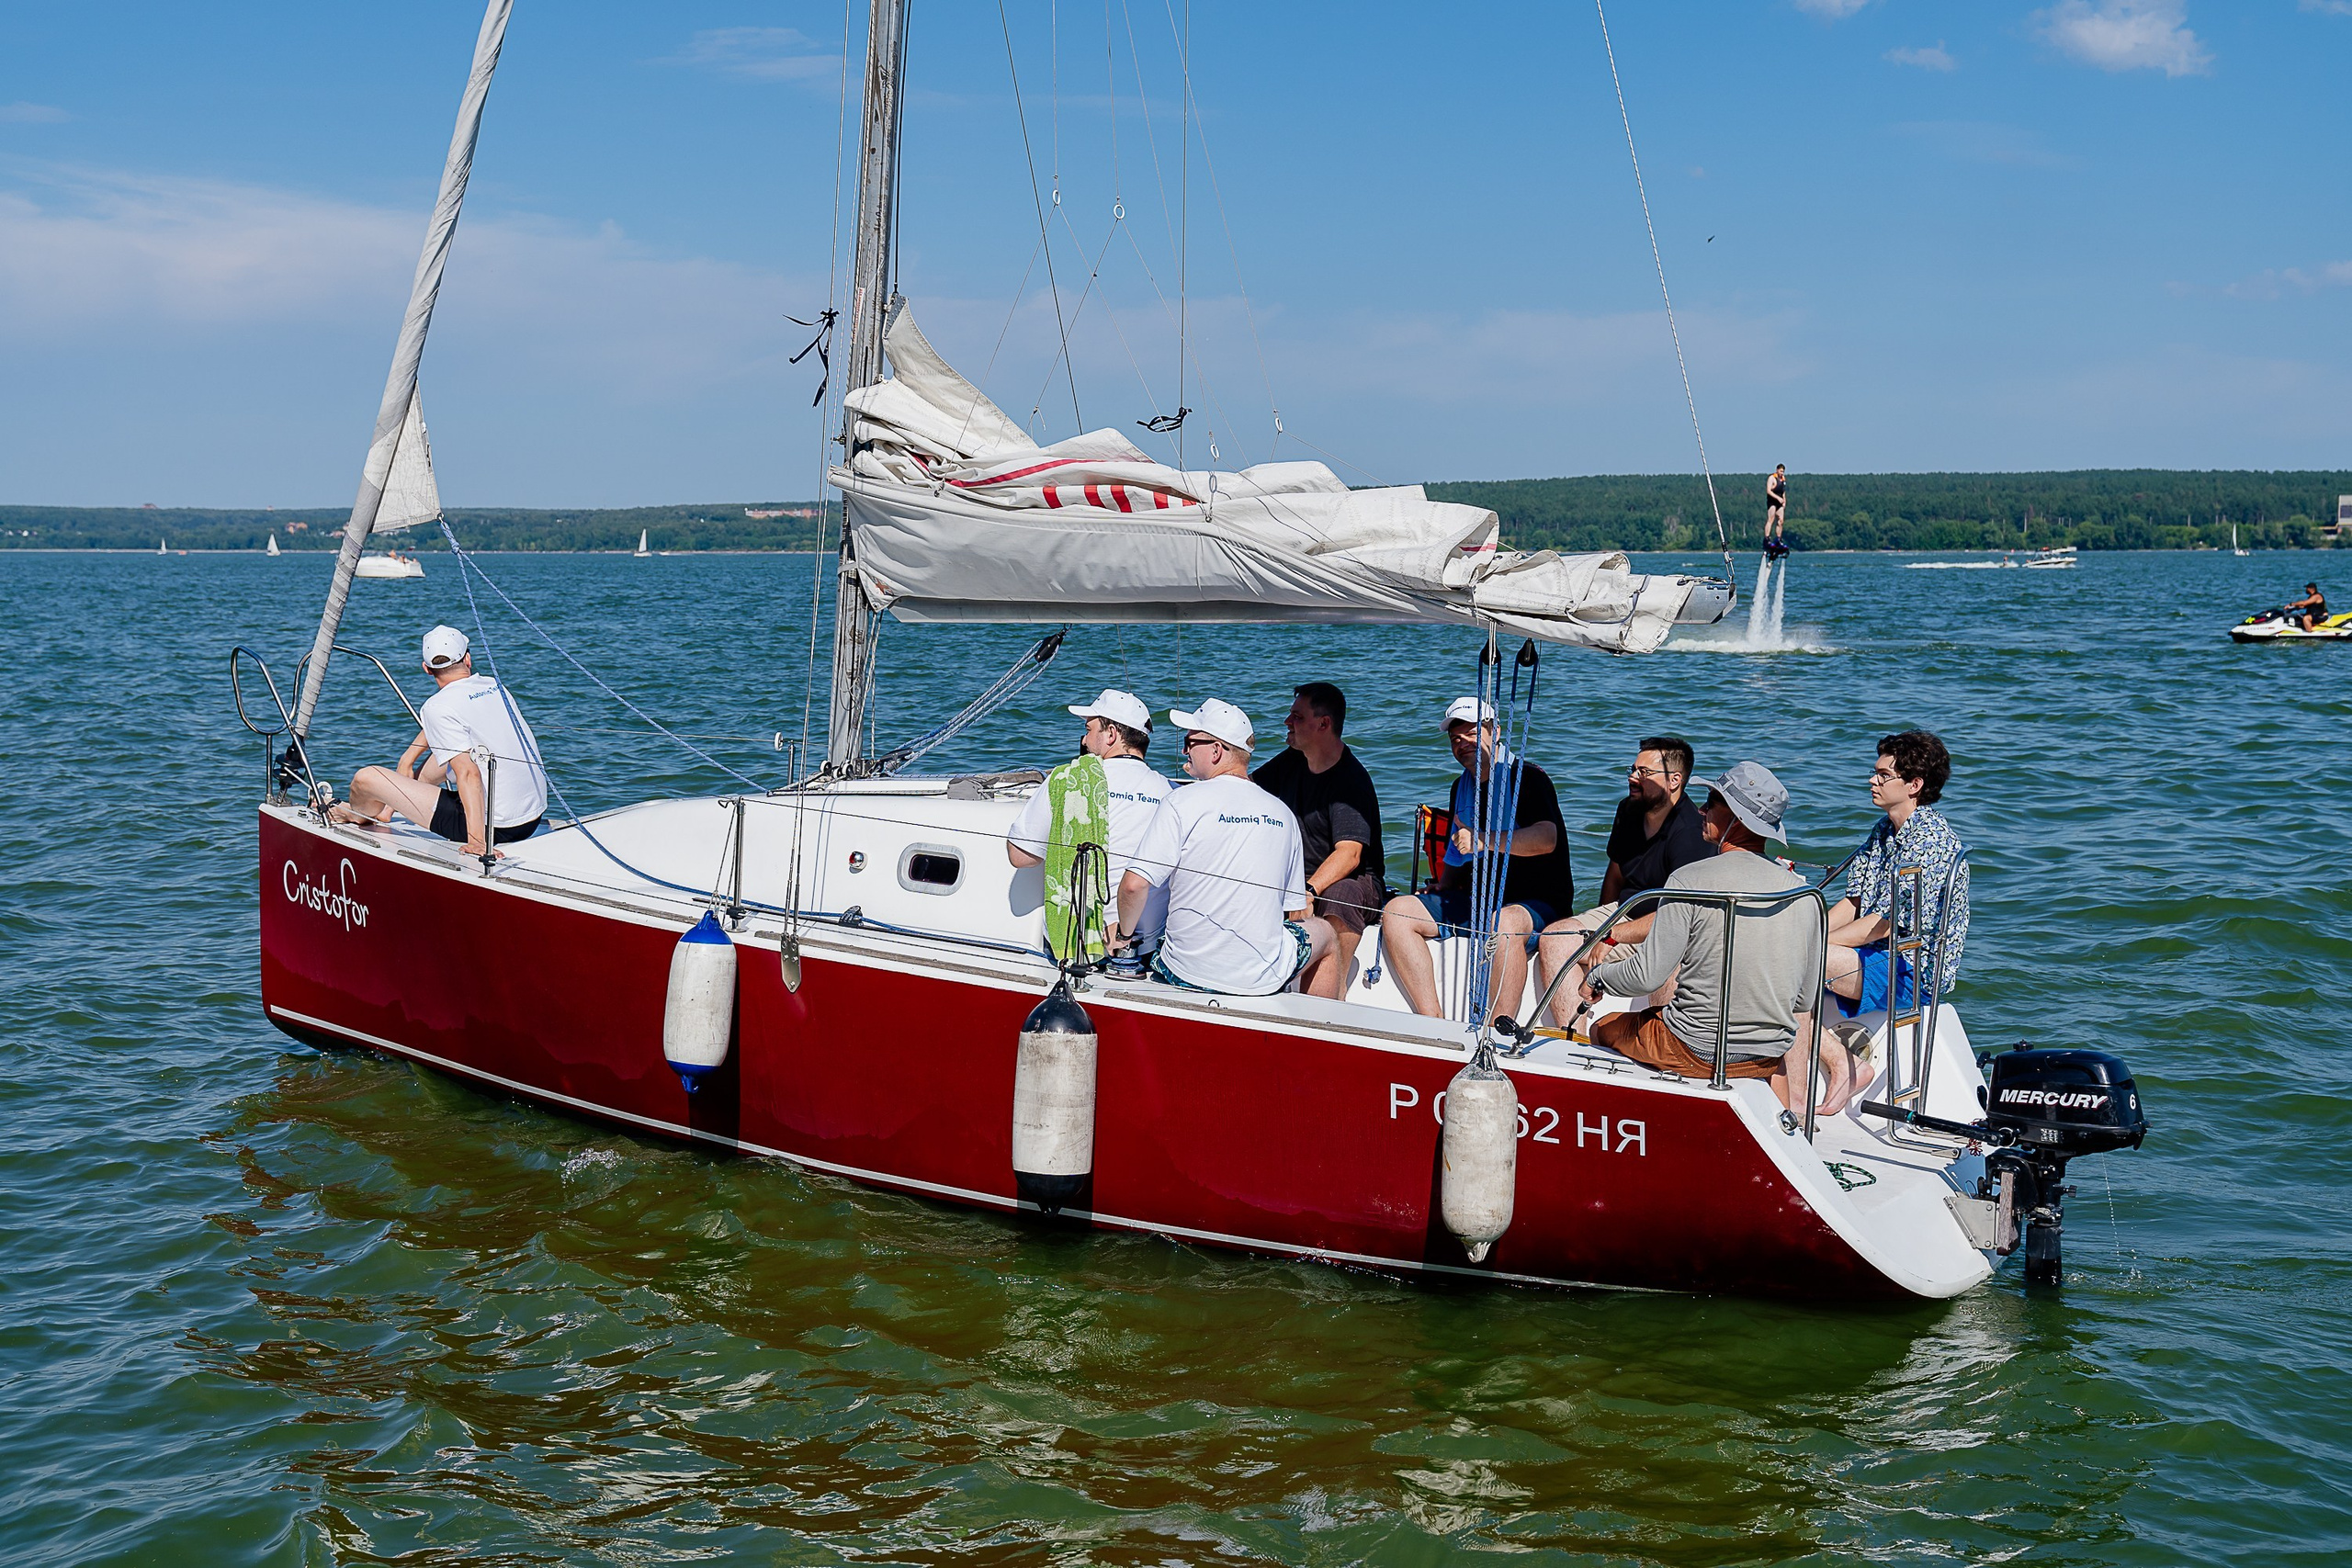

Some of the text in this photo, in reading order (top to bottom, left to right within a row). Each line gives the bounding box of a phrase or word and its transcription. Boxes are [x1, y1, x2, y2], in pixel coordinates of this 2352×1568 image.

[1107, 790, 1160, 805] omiq Team
[1218, 813, 1283, 828] Automiq Team
[283, 857, 369, 932] Cristofor
[1999, 1089, 2109, 1109] MERCURY
[2129, 1093, 2137, 1111] 6
[1577, 1111, 1646, 1157] НЯ
